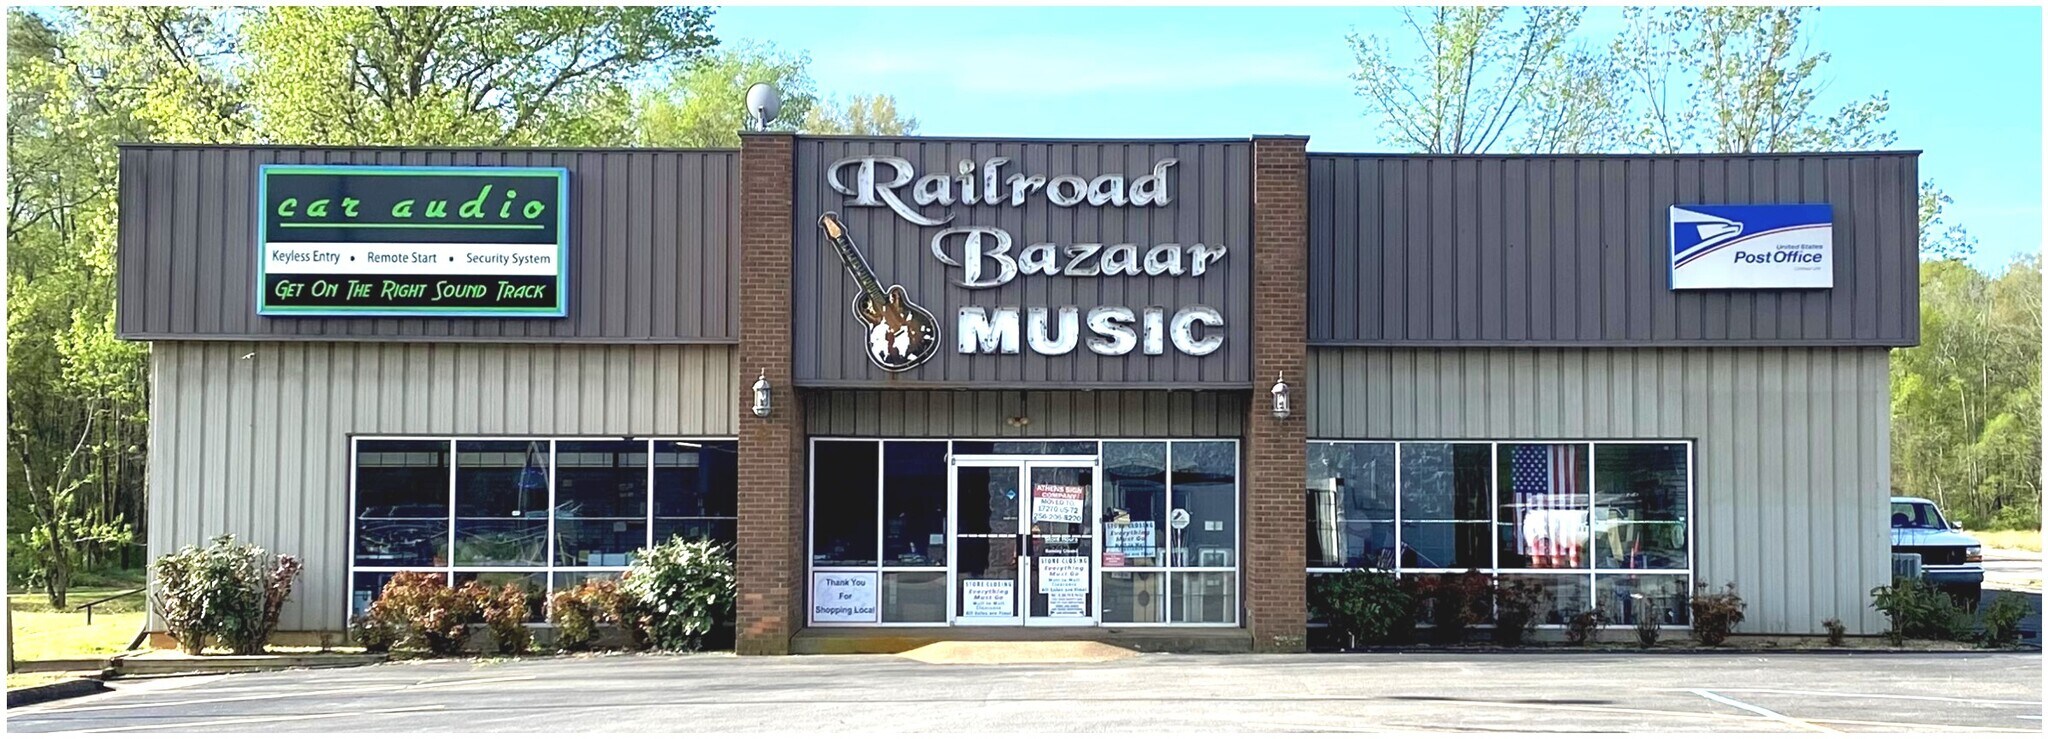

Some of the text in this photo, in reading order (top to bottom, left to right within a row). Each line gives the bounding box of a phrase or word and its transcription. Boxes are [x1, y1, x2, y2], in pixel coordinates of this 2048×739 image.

[827, 155, 1179, 226] Railroad
[277, 184, 545, 219] car audio
[272, 250, 551, 266] Keyless Entry Remote Start Security System
[931, 225, 1228, 289] Bazaar
[1734, 250, 1822, 264] Post Office
[958, 304, 1225, 356] MUSIC
[826, 578, 866, 586] Thank You
[838, 592, 852, 600] For
[815, 605, 876, 616] Shopping Local
